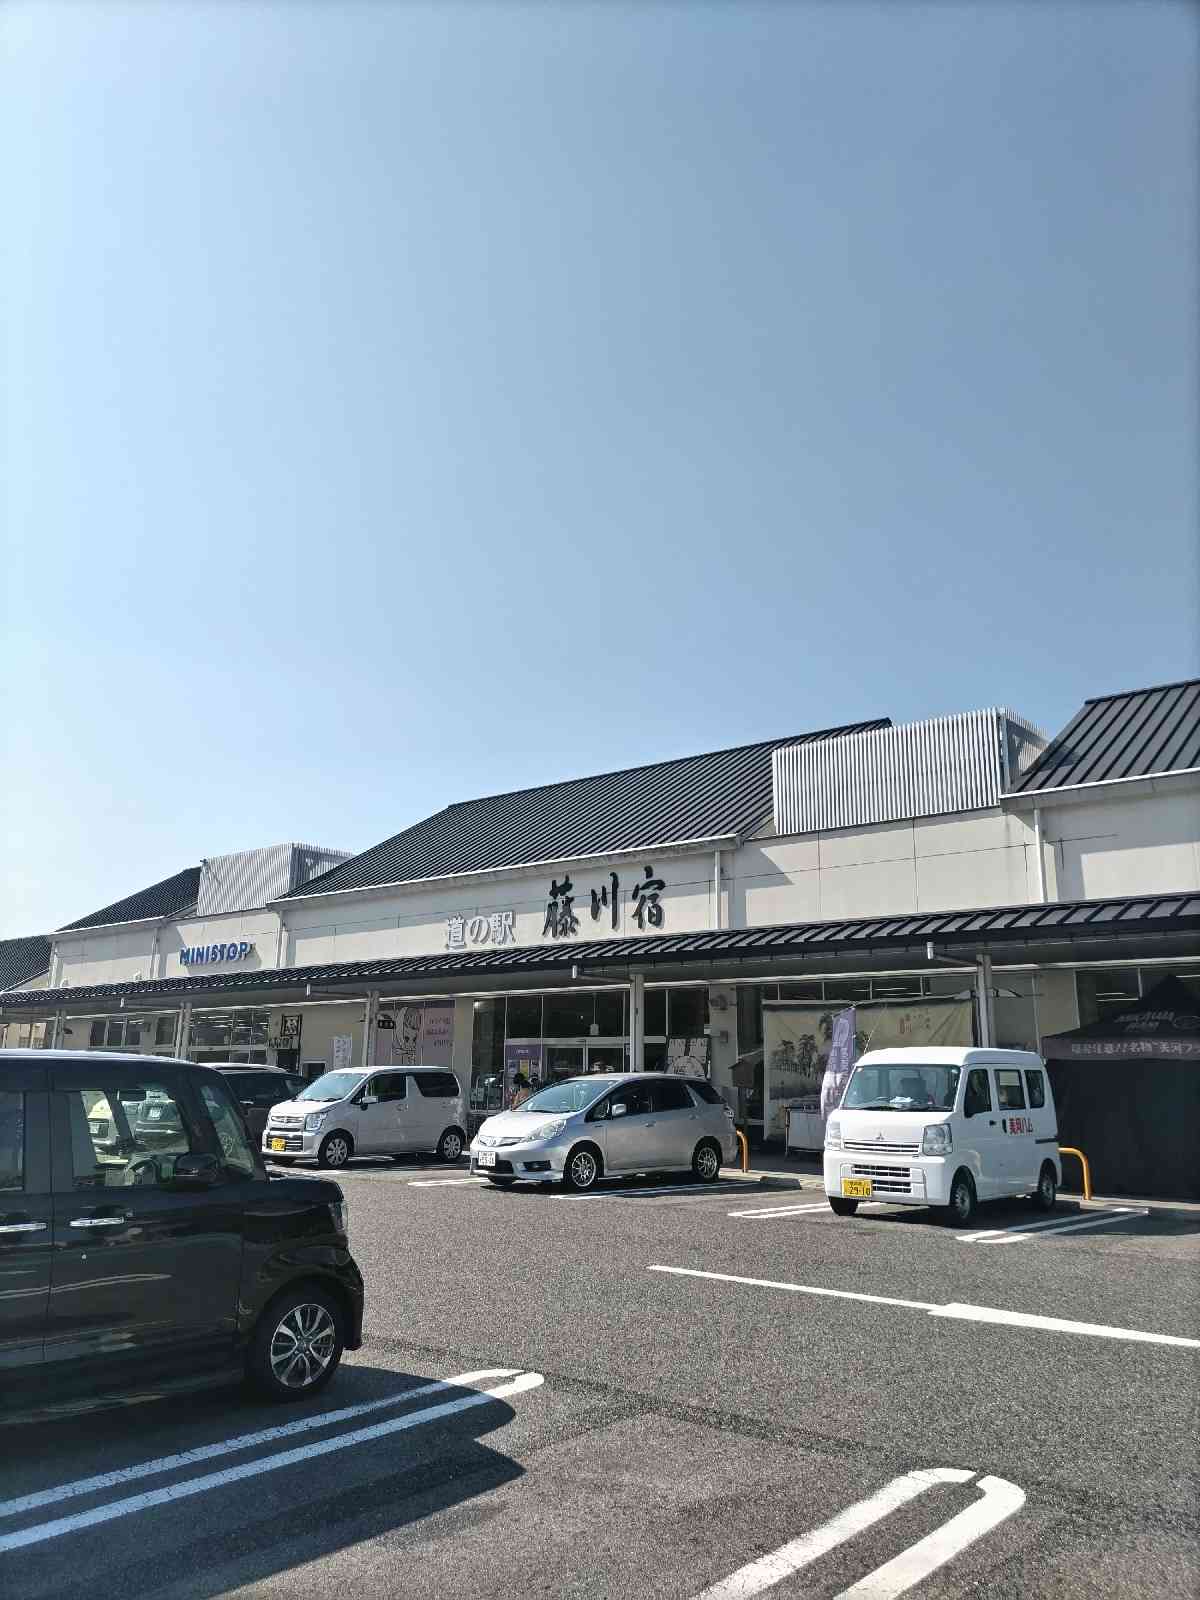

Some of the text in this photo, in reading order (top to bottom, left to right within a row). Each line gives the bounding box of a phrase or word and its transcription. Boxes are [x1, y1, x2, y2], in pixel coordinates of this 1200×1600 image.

[446, 865, 666, 950] 道の駅 藤川宿
[179, 942, 250, 965] MINISTOP
